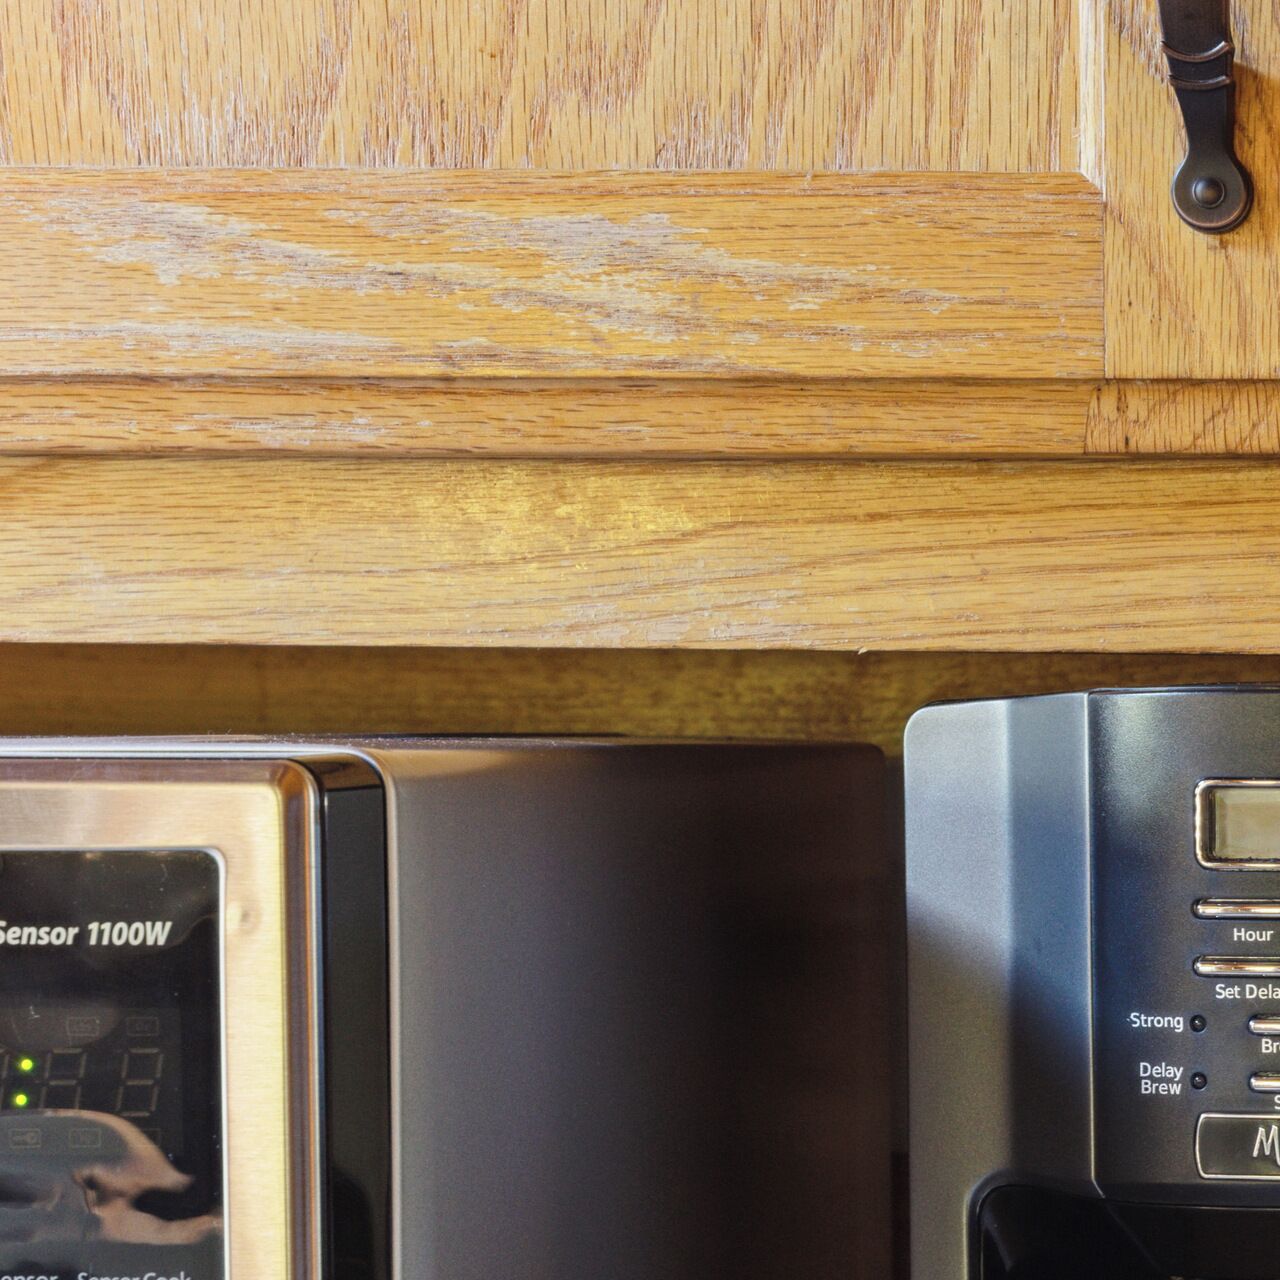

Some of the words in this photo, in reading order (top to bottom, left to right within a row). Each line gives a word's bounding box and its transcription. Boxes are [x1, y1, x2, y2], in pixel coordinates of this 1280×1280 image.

[88, 921, 172, 946] 1100W
[1234, 927, 1273, 942] Hour
[1215, 985, 1240, 999] Set
[1130, 1013, 1183, 1033] Strong
[1140, 1063, 1183, 1081] Delay
[1140, 1080, 1181, 1095] Brew
